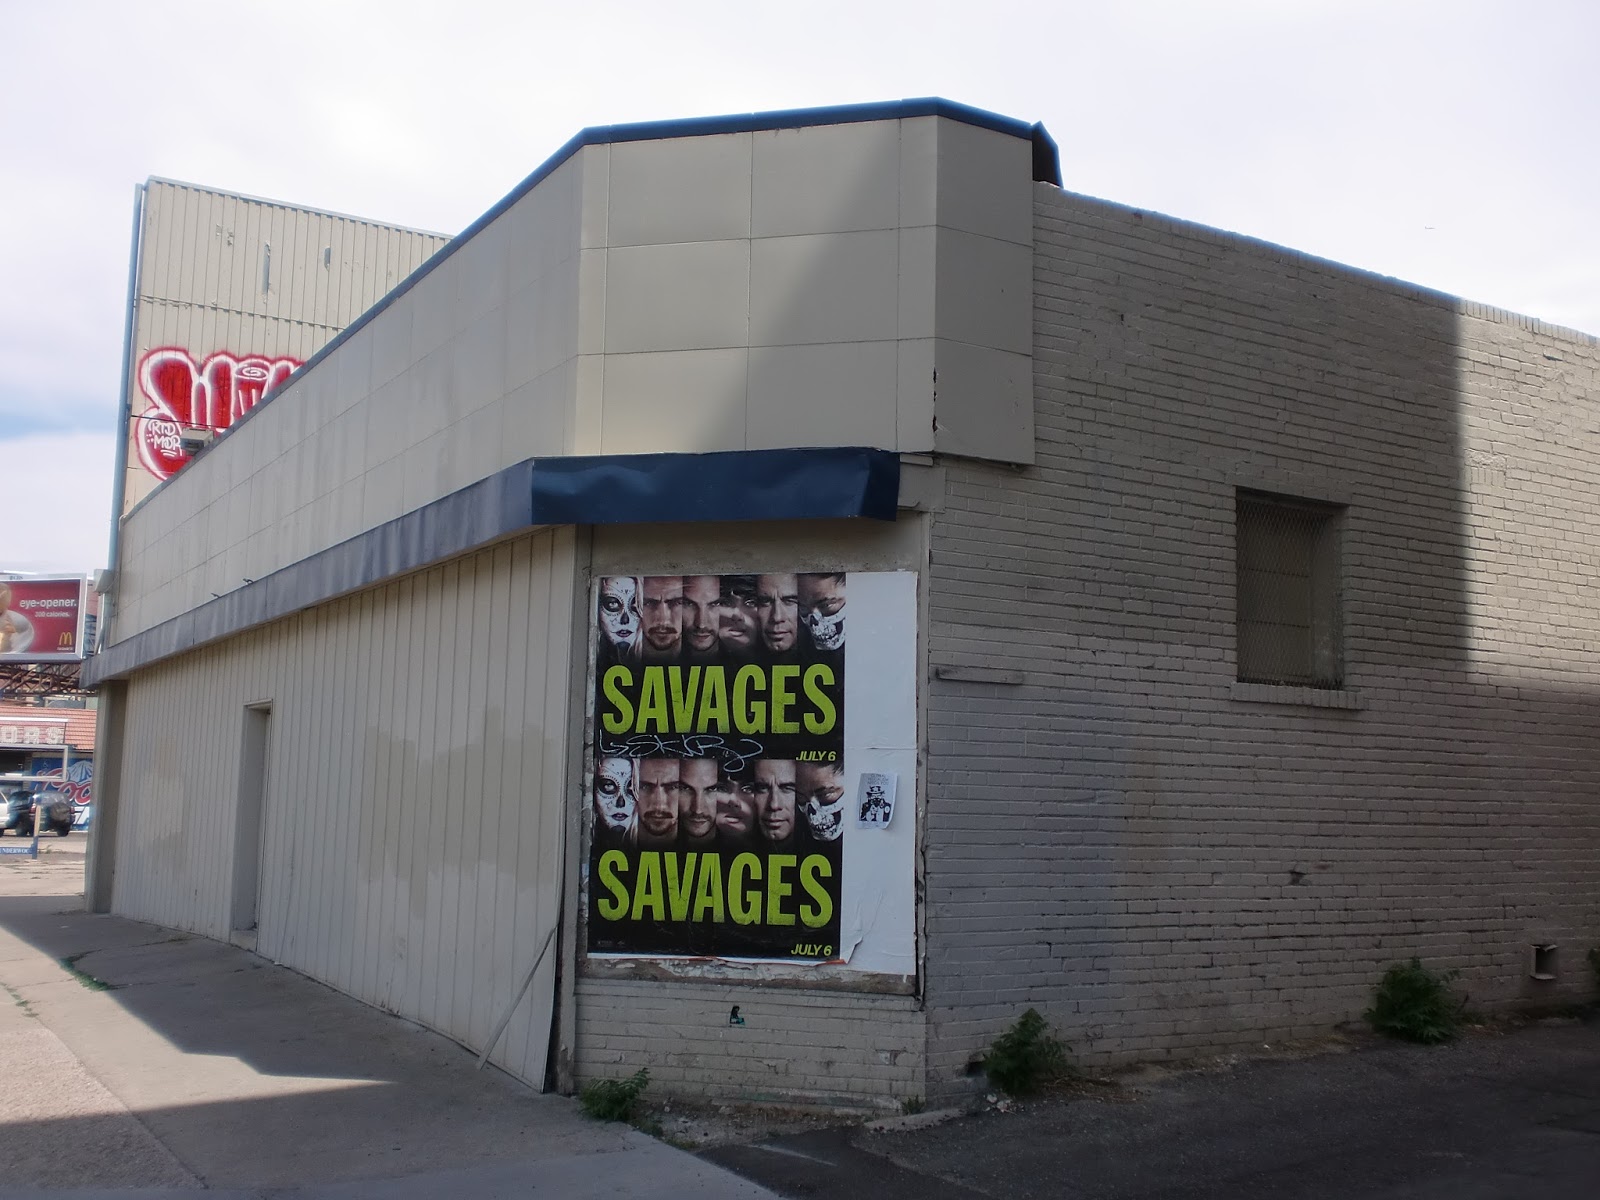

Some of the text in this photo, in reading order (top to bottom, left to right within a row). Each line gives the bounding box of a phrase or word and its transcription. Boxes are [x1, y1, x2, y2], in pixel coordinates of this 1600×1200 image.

[20, 599, 77, 610] eye-opener.
[602, 663, 837, 735] SAVAGES
[795, 750, 837, 761] JULY 6
[597, 849, 834, 929] SAVAGES
[790, 943, 833, 956] JULY 6
